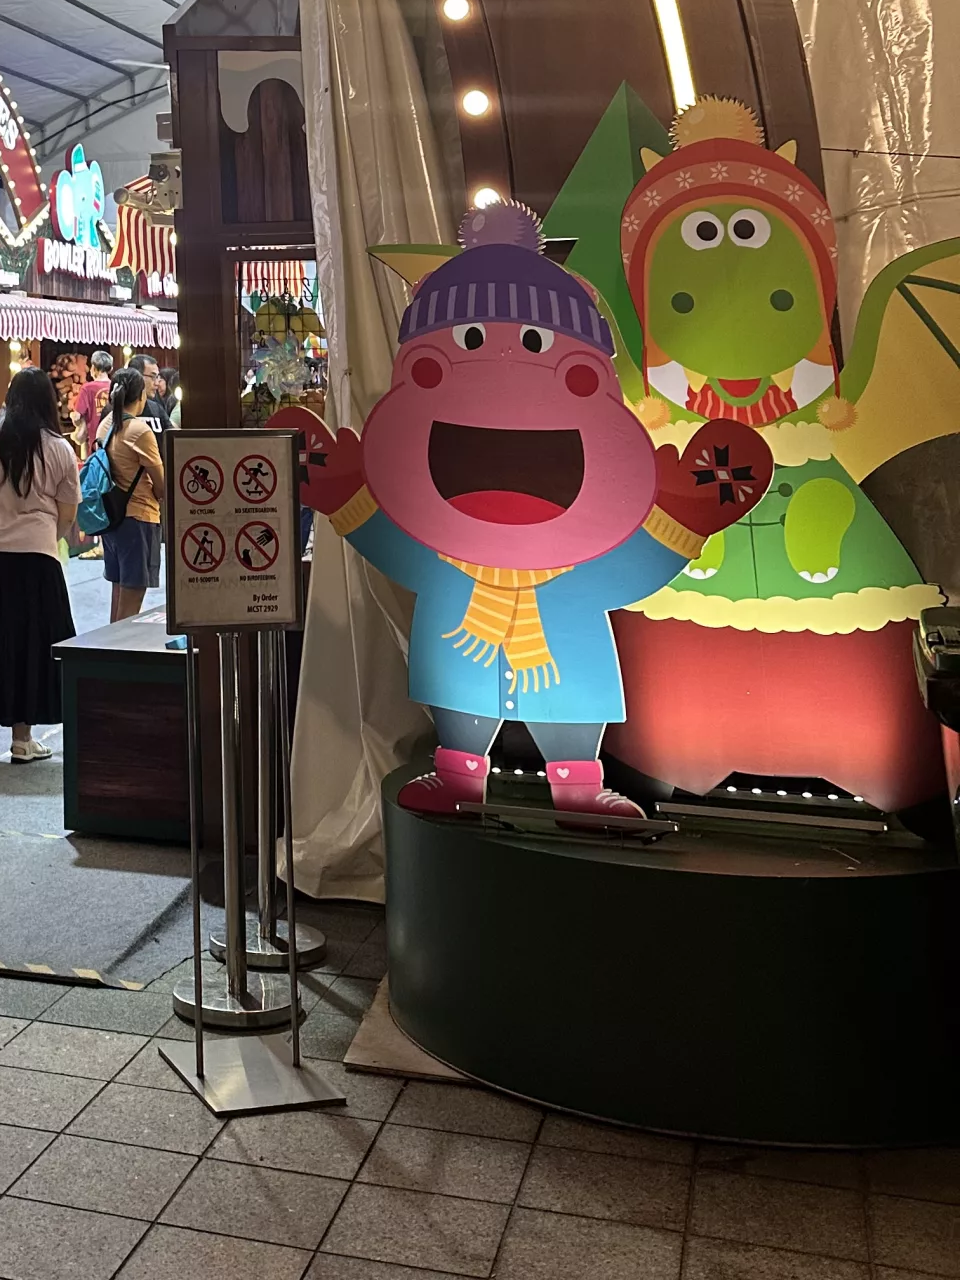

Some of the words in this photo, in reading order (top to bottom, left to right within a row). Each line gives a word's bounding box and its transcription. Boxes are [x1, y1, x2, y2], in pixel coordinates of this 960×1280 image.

[43, 238, 86, 280] BOWLER
[234, 507, 242, 515] NO
[252, 594, 261, 603] By
[261, 593, 279, 602] Order
[247, 605, 263, 613] MCST
[263, 604, 279, 613] 2929
